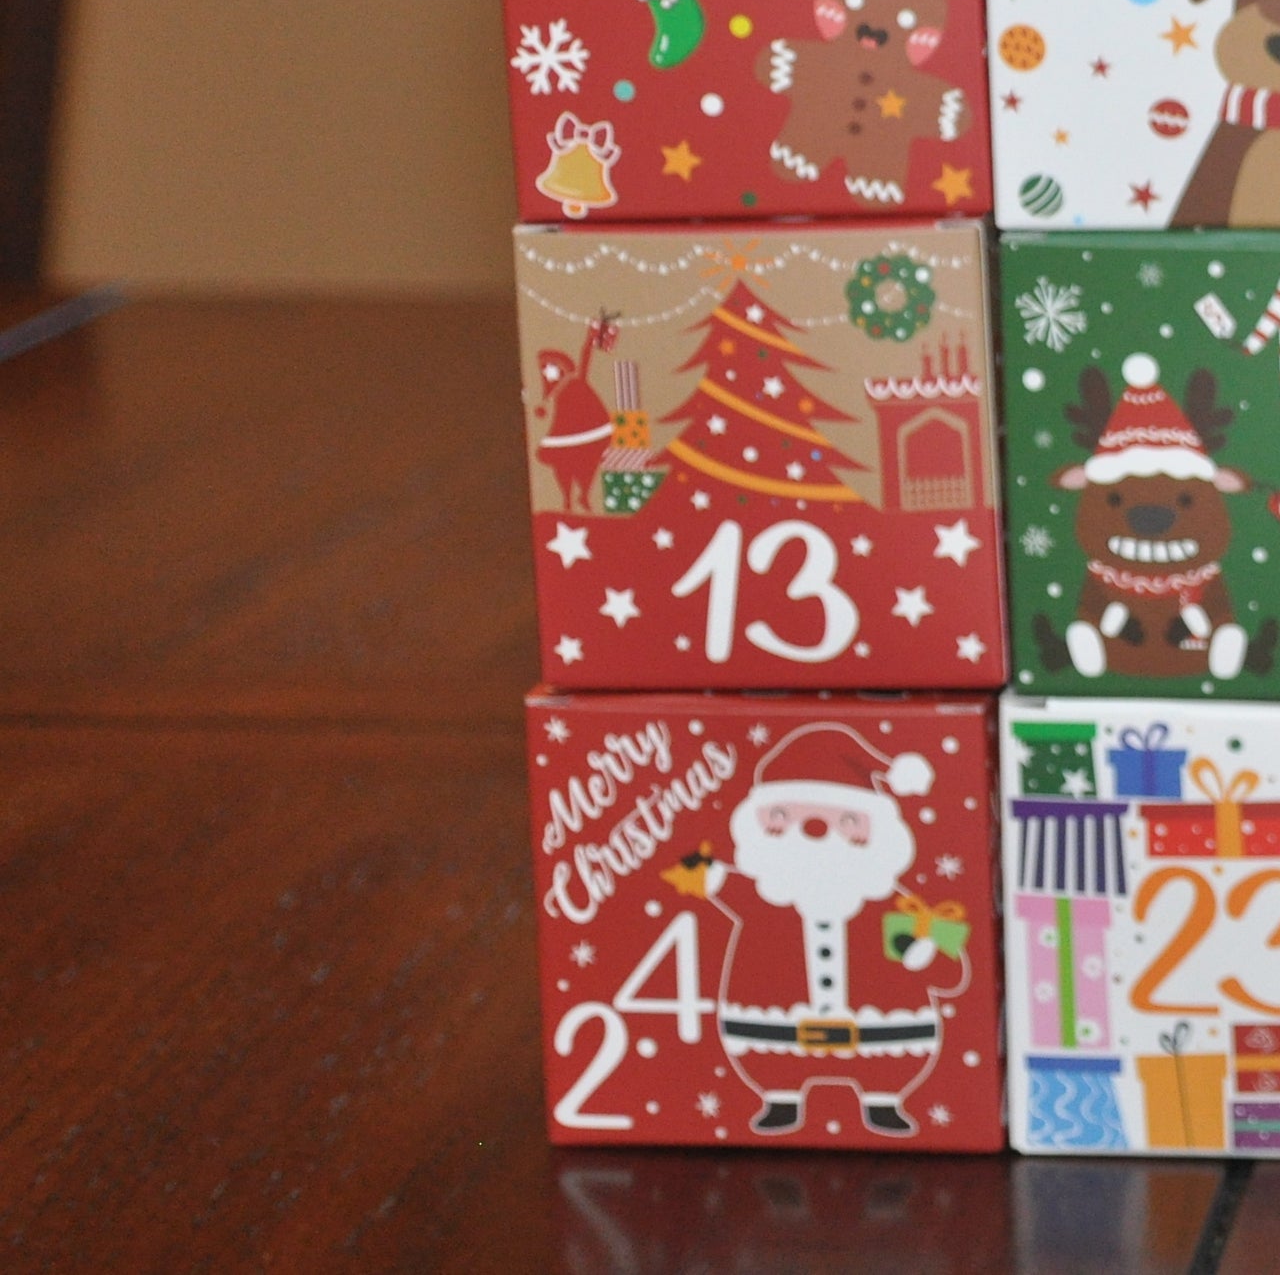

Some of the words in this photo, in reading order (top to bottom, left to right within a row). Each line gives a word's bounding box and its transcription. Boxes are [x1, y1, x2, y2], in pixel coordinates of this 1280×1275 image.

[672, 519, 860, 664] 13
[542, 719, 672, 854] Merry
[543, 741, 737, 924] Christmas
